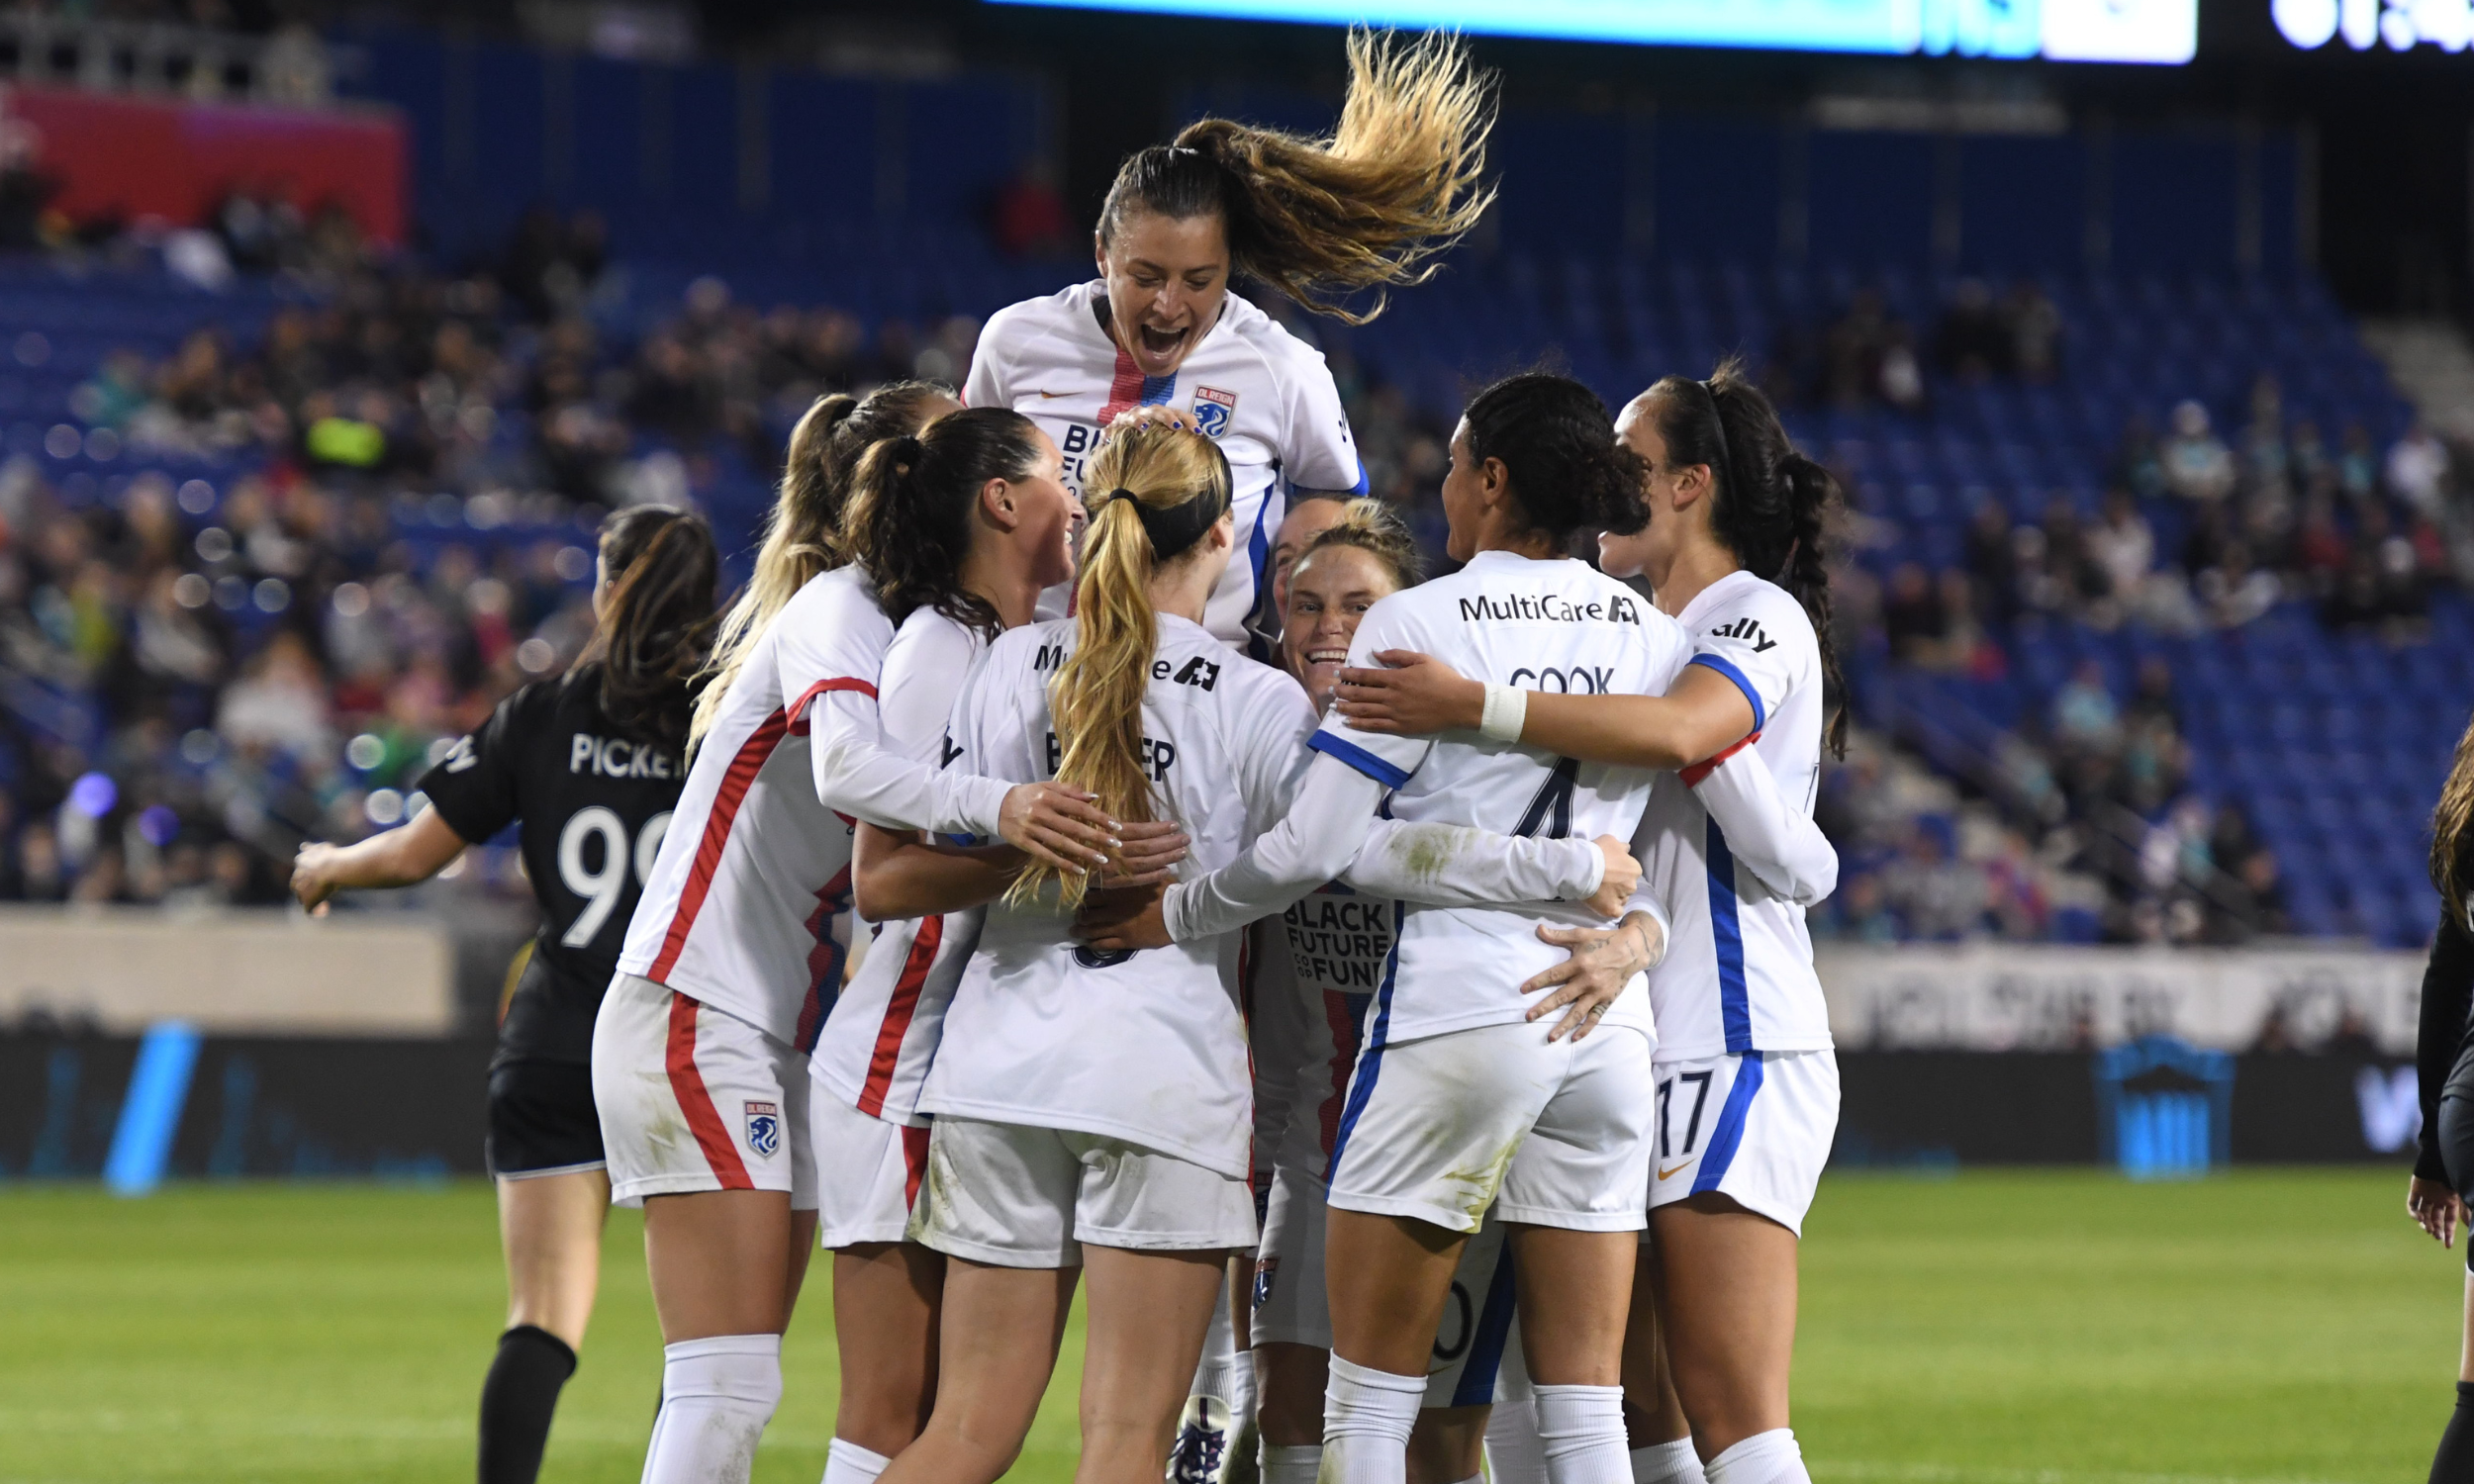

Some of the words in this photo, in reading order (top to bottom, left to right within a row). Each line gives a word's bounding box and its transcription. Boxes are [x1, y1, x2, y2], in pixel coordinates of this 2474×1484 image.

[1198, 388, 1208, 398] OL
[1208, 391, 1234, 406] REIGN
[1459, 594, 1603, 622] MultiCare
[1711, 617, 1777, 653] ally
[1284, 899, 1386, 932] BLACK
[1286, 927, 1388, 958] FUTURE
[1657, 1068, 1715, 1159] 17
